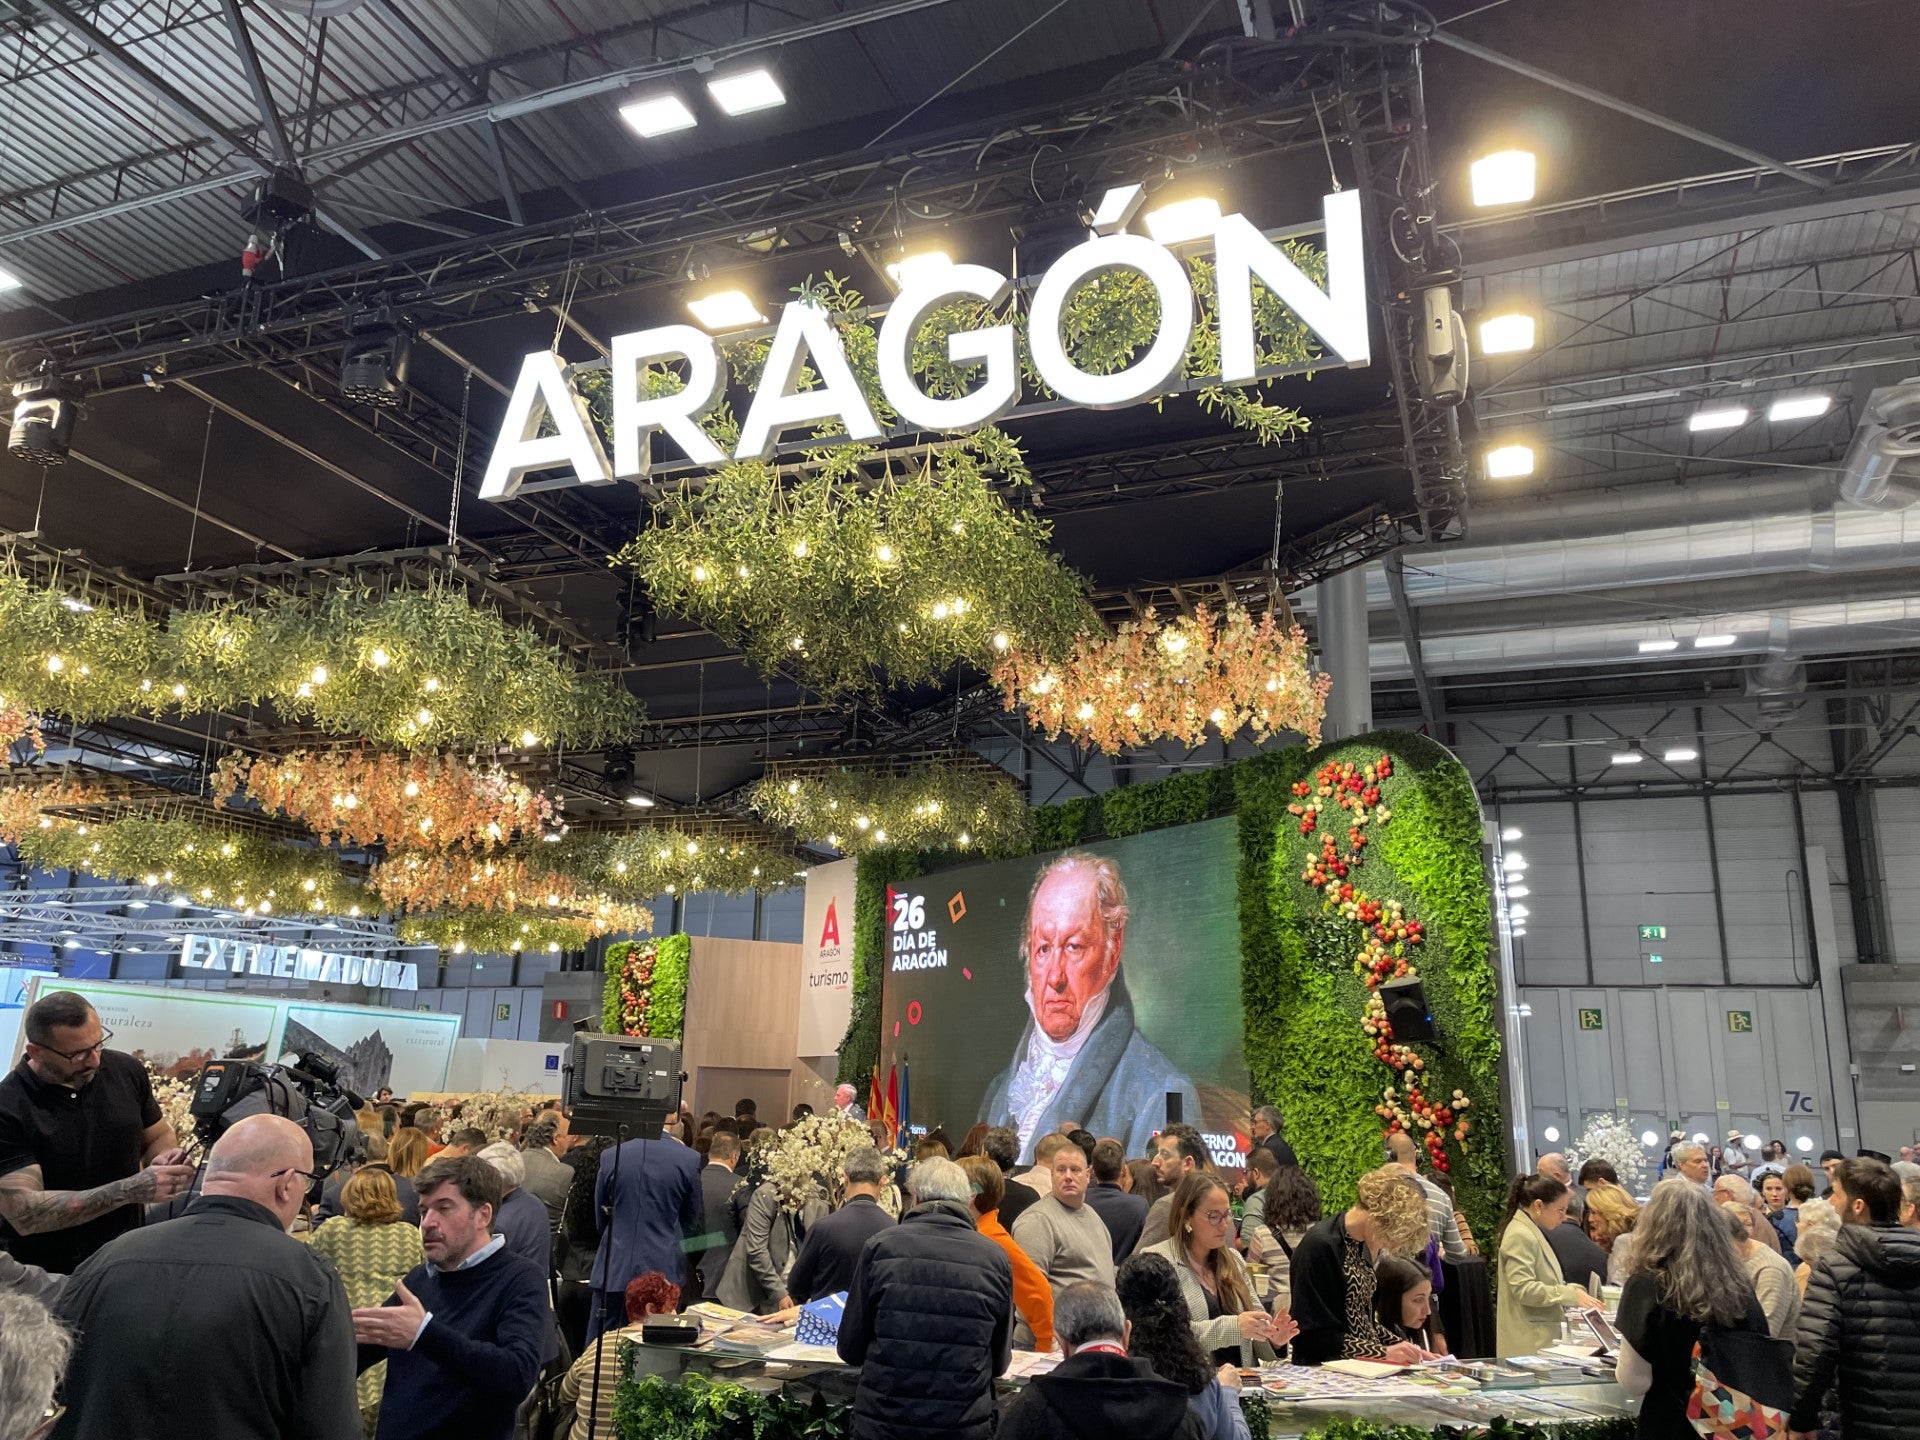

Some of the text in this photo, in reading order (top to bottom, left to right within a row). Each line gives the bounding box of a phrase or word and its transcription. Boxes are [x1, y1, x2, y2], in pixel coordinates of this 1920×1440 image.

[478, 184, 1371, 500] ARAGÓN
[893, 895, 926, 932] 26
[820, 946, 841, 958] ARAGÓN
[893, 930, 937, 952] DÍA DE
[180, 933, 419, 991] EXTREMADURA
[892, 946, 948, 972] ARAGÓN
[809, 969, 849, 987] turismo
[100, 1015, 153, 1028] aturaleza
[1201, 1133, 1237, 1151] ERNO
